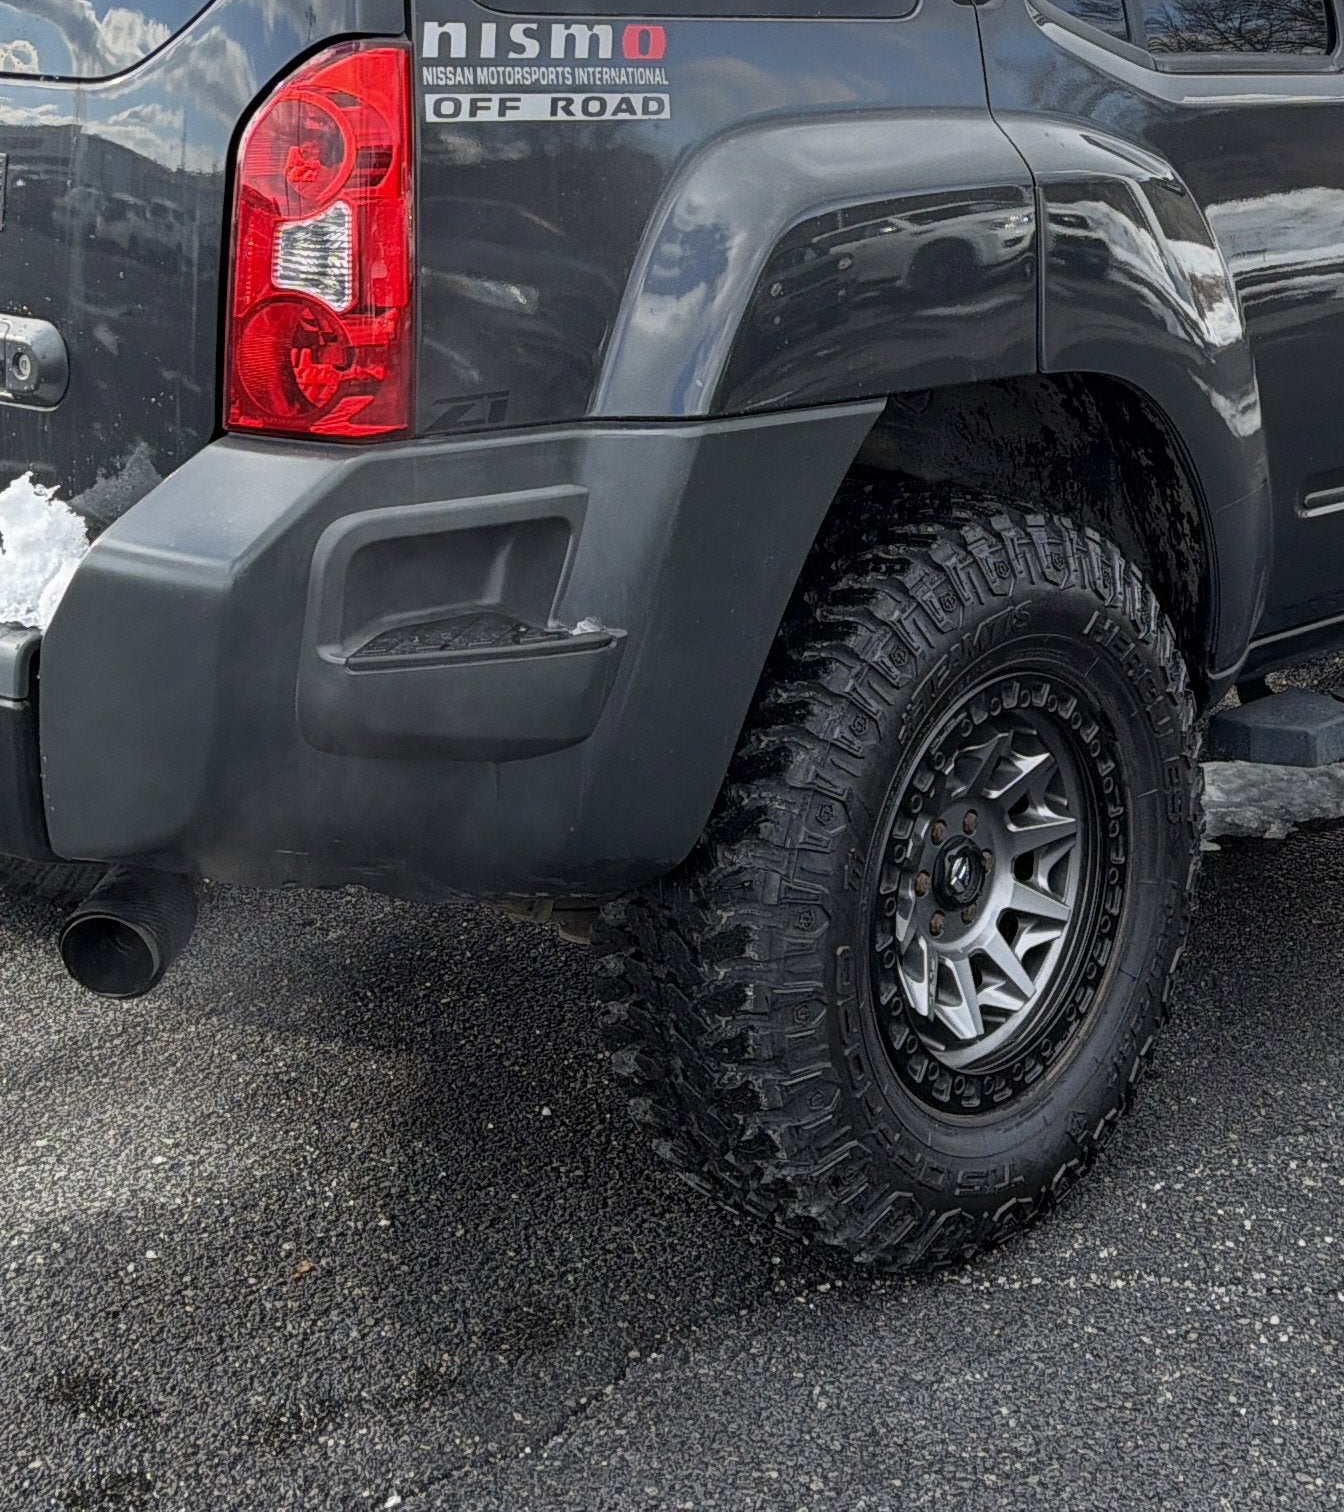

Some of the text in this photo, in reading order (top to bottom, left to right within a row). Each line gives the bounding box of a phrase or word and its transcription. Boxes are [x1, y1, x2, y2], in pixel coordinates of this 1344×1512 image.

[422, 21, 668, 61] nismo
[422, 66, 669, 86] NISSAN MOTORSPORTS INTERNATIONAL
[432, 95, 666, 120] OFF ROAD
